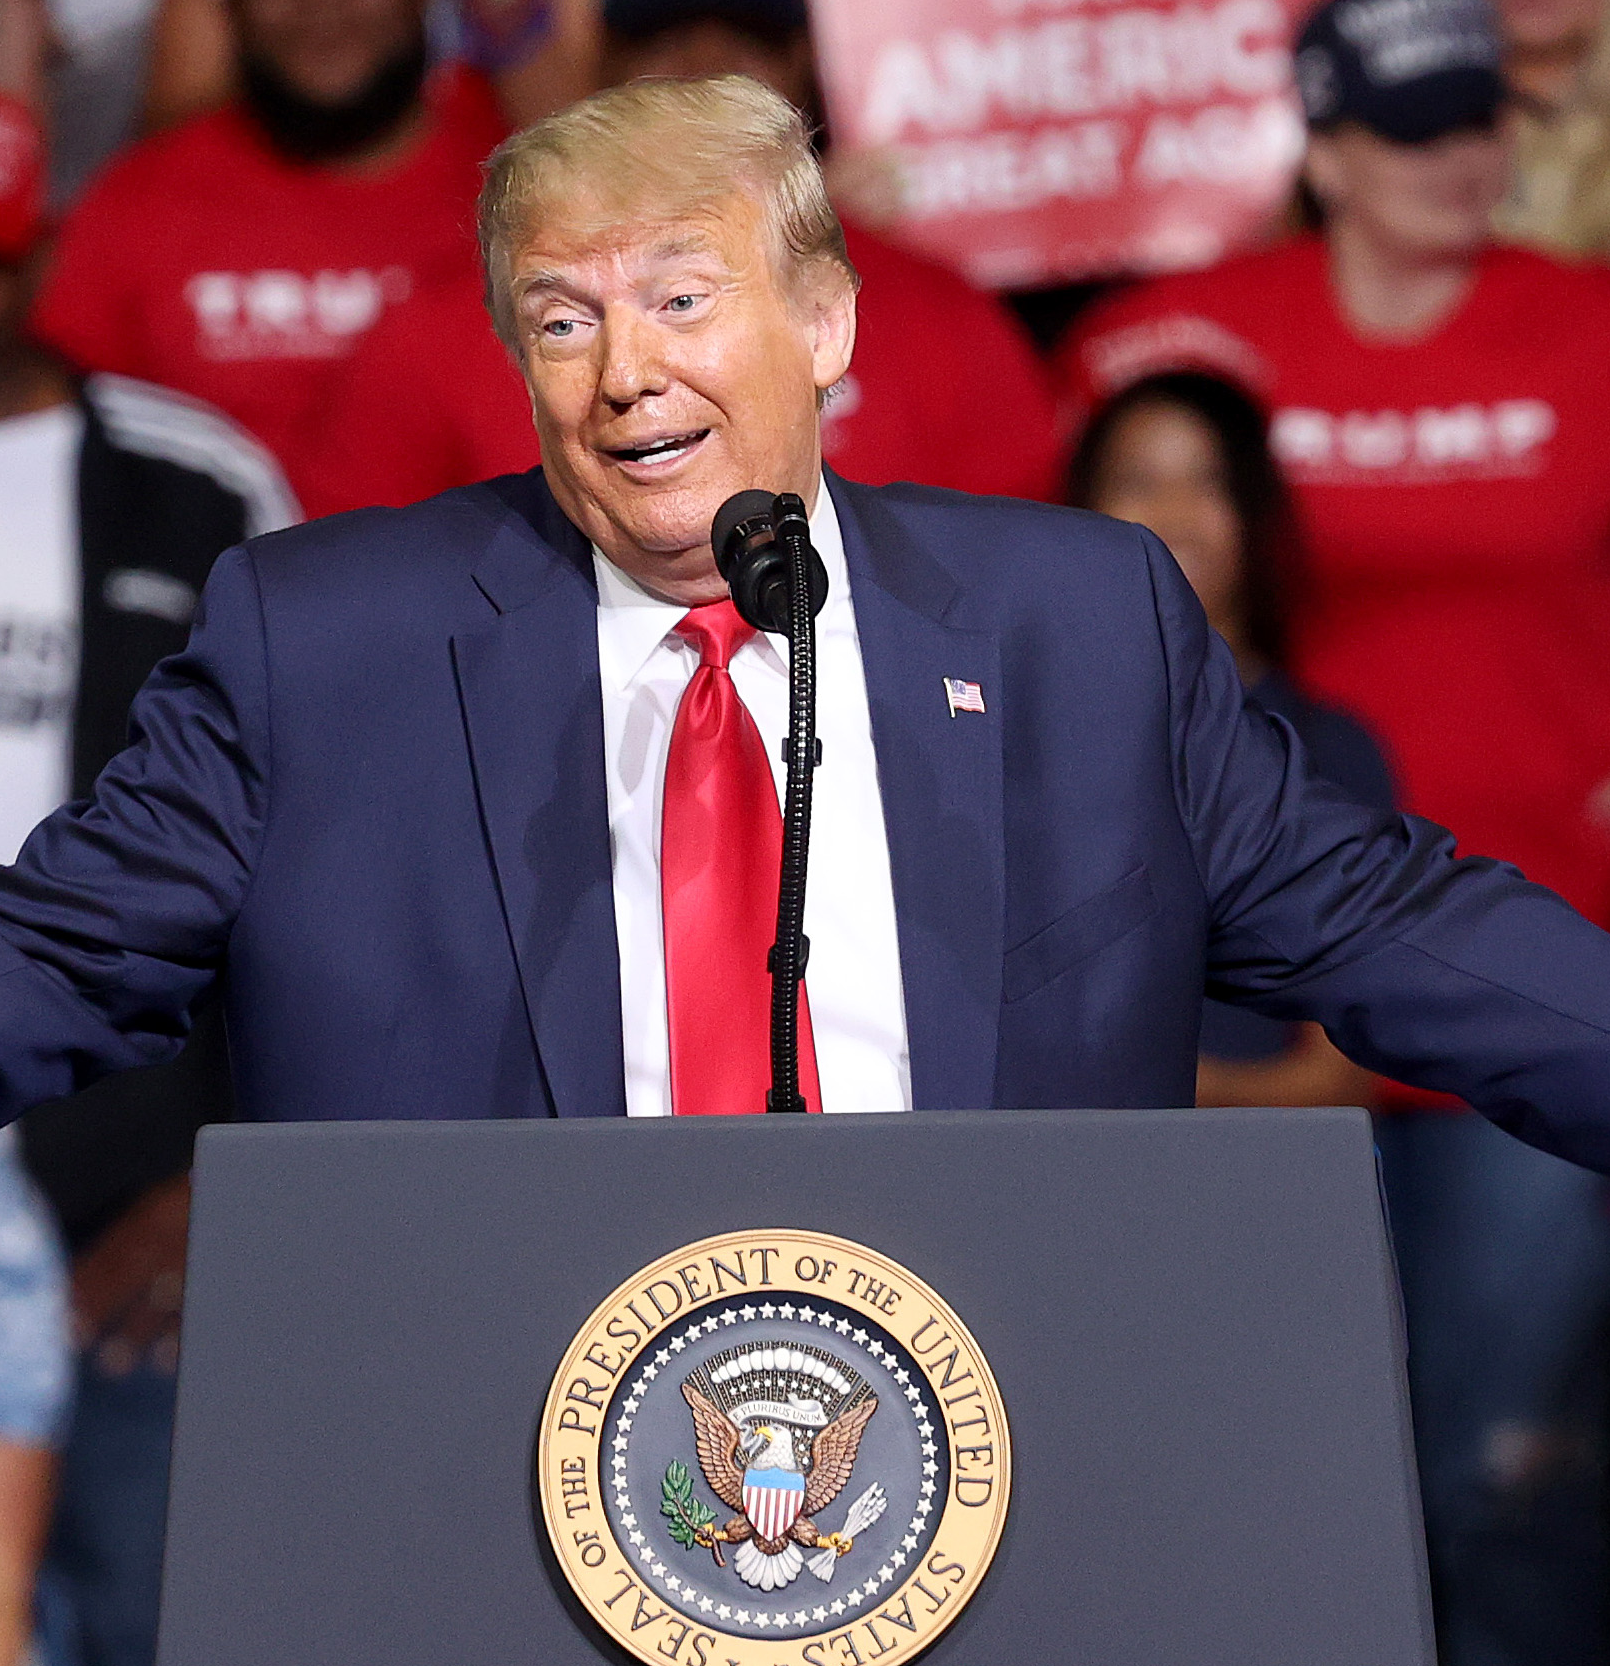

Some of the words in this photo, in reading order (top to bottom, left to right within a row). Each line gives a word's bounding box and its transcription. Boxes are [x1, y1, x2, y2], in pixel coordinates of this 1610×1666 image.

[1268, 400, 1559, 468] RUMP
[794, 1255, 837, 1286] OF
[849, 1268, 903, 1316] THE
[559, 1246, 780, 1437] PRESIDENT
[732, 1411, 742, 1421] E
[741, 1402, 792, 1418] PLURIBUS
[792, 1410, 823, 1423] UNUM
[911, 1315, 994, 1509] UNITED
[560, 1455, 590, 1520] THE
[572, 1529, 606, 1569] OF
[604, 1567, 717, 1666] SEAL
[802, 1550, 966, 1666] STATES
